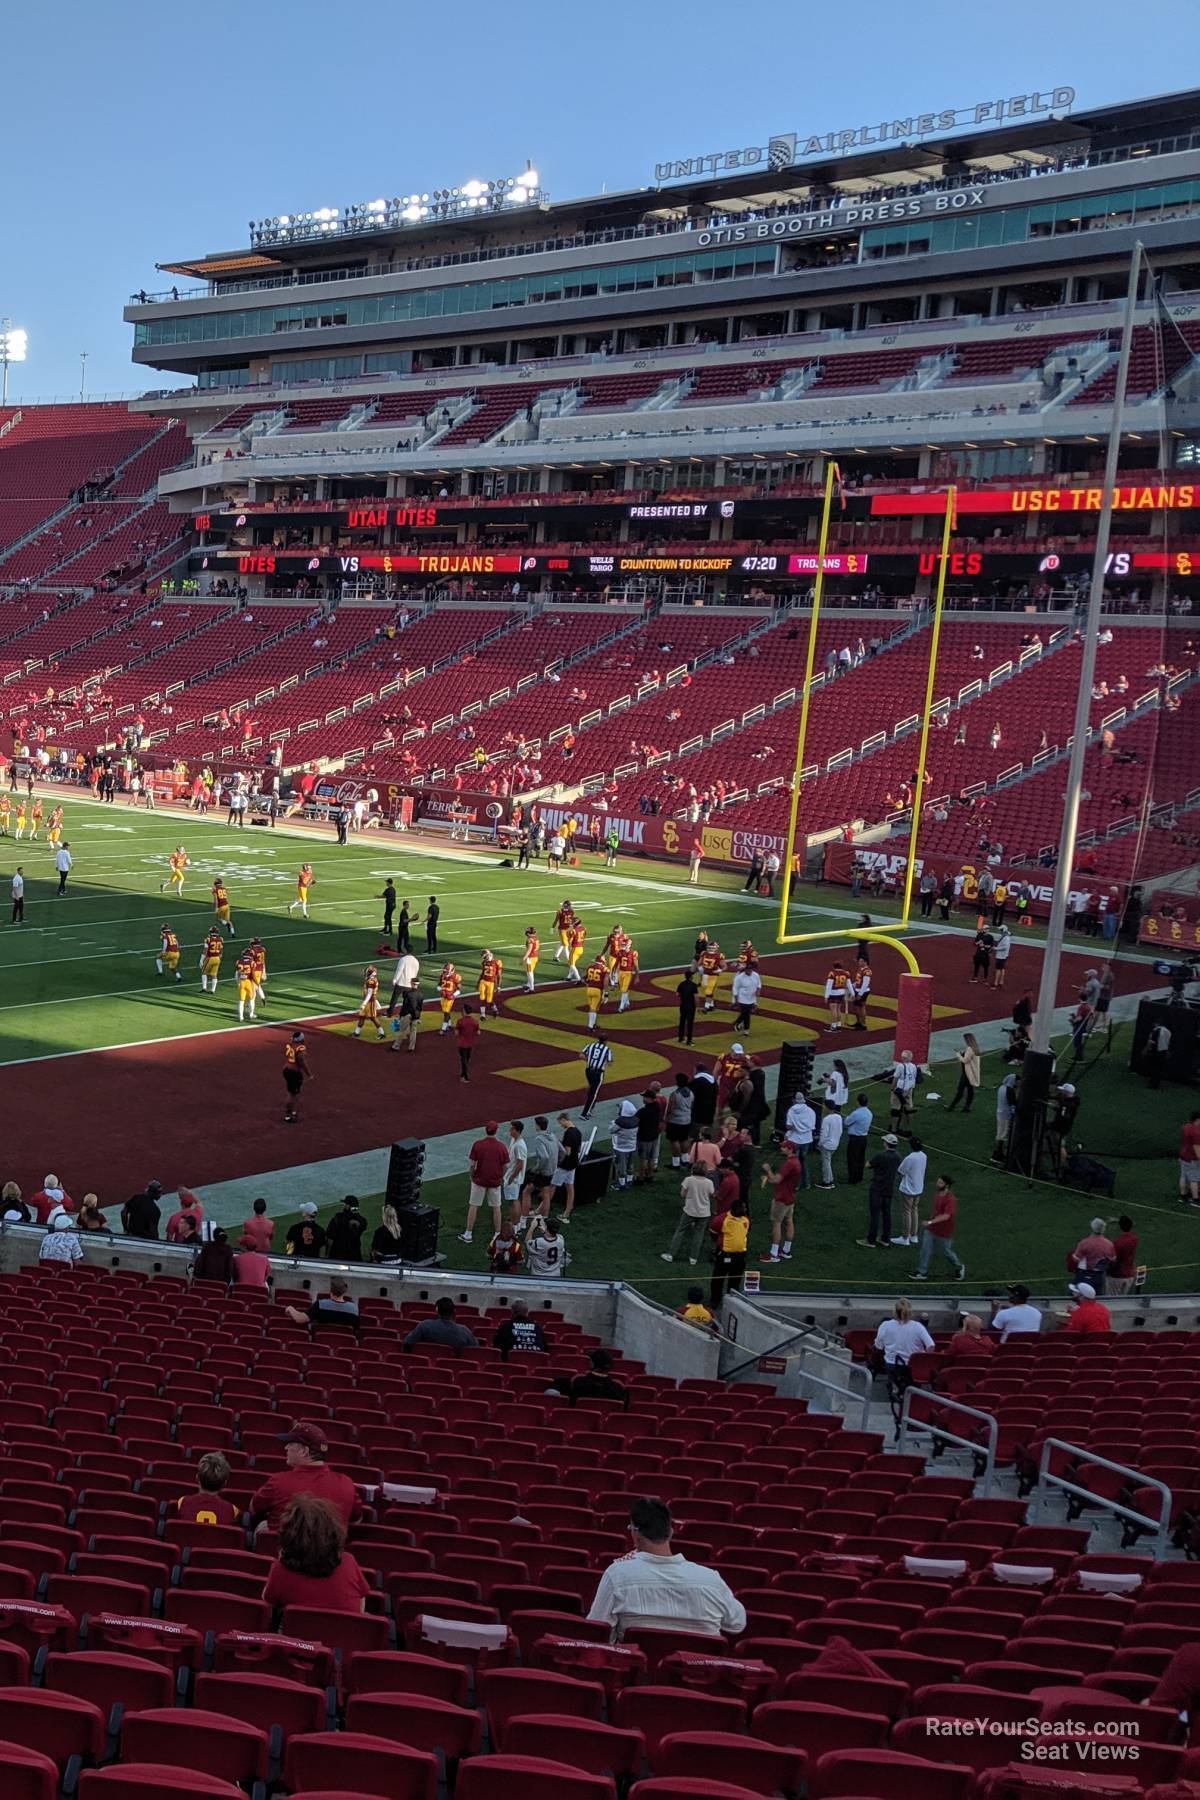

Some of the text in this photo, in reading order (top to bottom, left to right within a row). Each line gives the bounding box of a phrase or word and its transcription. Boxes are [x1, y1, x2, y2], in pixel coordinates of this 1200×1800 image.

[655, 86, 1076, 181] UNITED AIRLINES FIELD
[698, 189, 986, 246] OTIS BOOTH PRESS BOX
[1011, 489, 1060, 512] USC
[347, 508, 437, 528] UTAH UTES
[630, 504, 708, 518] PRESENTED BY
[195, 514, 211, 530] UTES
[239, 556, 276, 573] UTES
[340, 556, 360, 571] VS
[418, 556, 495, 573] TROJANS
[548, 559, 569, 569] UTES
[589, 556, 614, 564] WELLS
[589, 564, 614, 572] FARGO
[692, 558, 733, 570] KICKOFF
[741, 557, 777, 571] 47:20
[603, 816, 646, 844] MILK
[703, 830, 788, 851] USC CREDIT
[547, 1247, 558, 1265] 9
